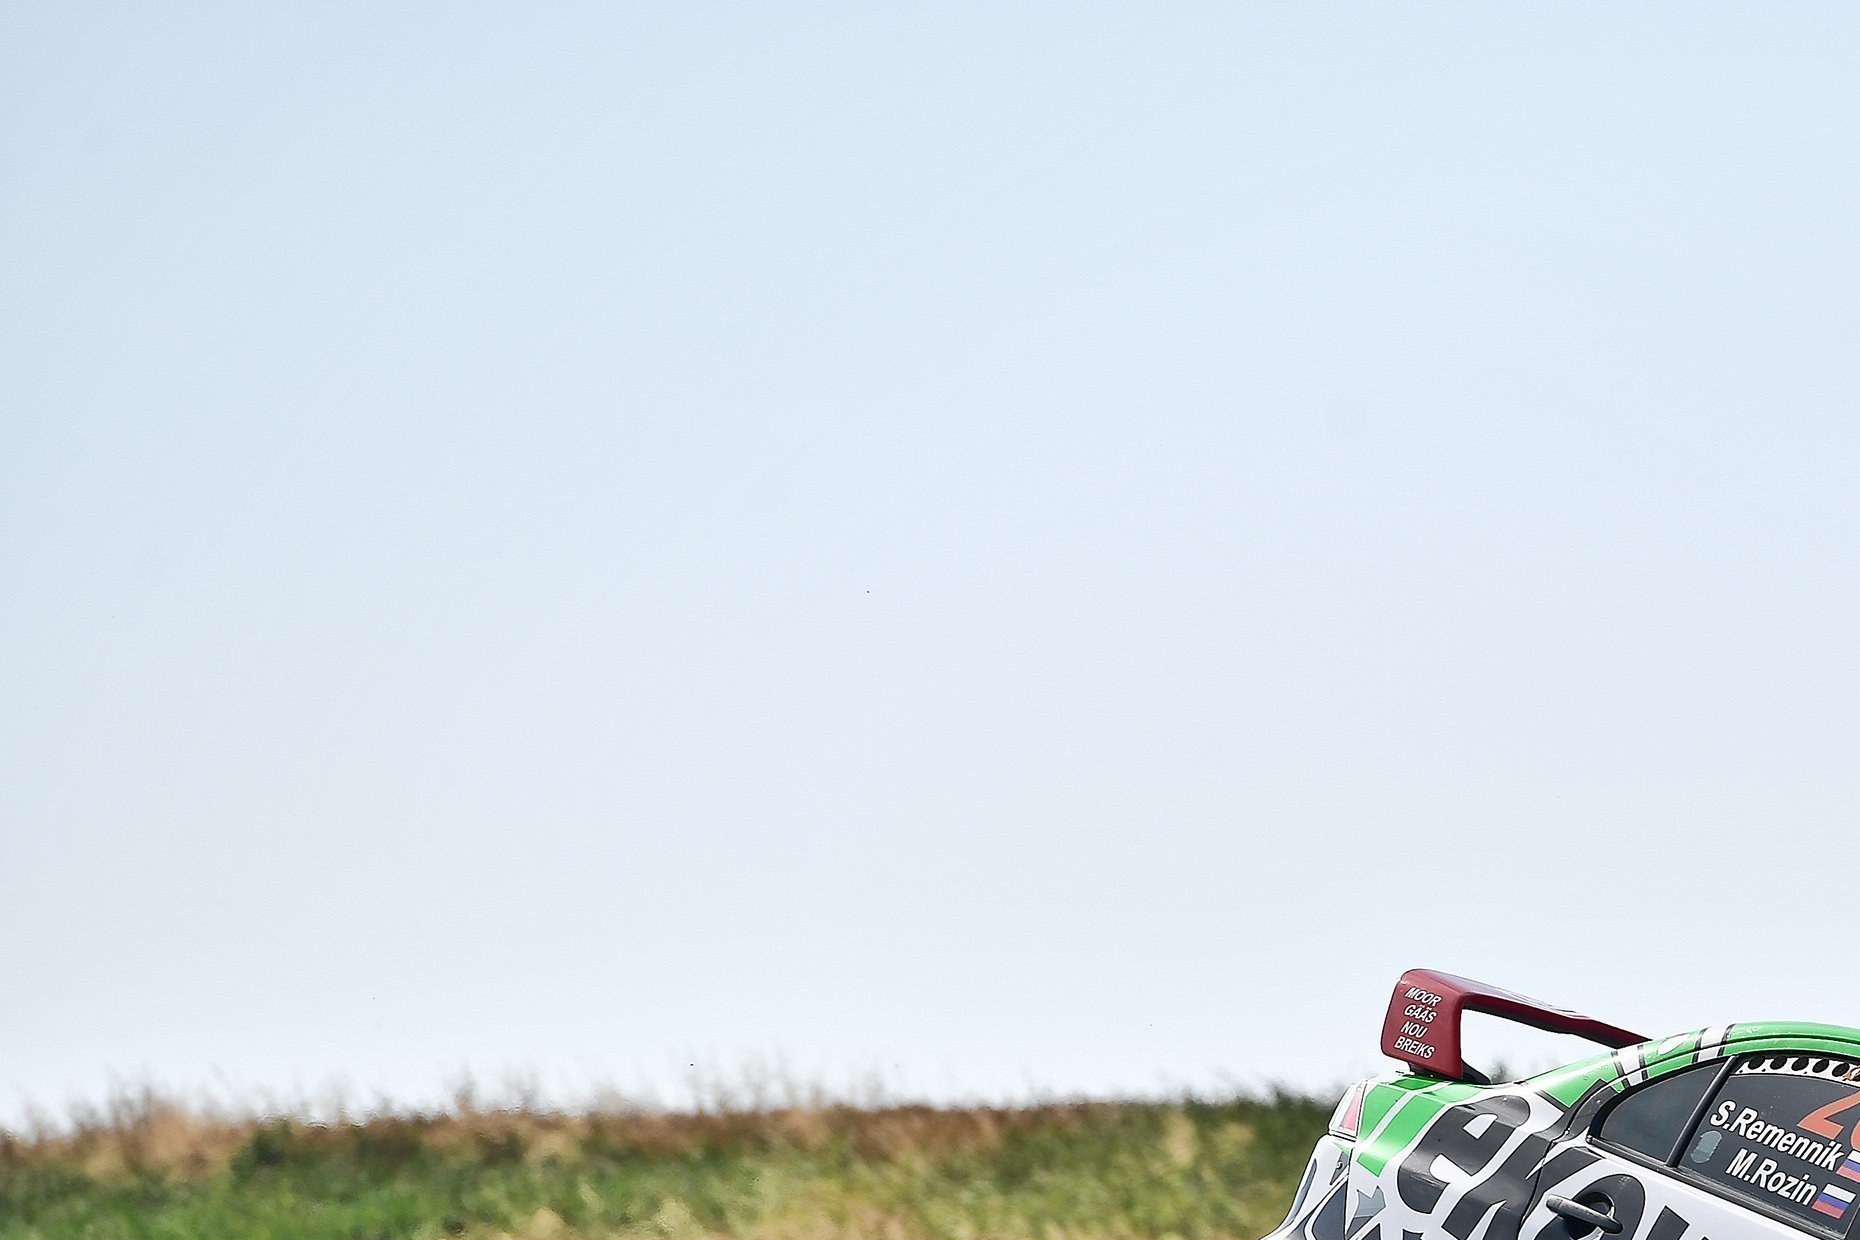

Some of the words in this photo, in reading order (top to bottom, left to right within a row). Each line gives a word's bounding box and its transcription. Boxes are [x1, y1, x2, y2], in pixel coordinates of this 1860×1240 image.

[1404, 986, 1442, 1007] MOOR
[1400, 1020, 1428, 1038] NOU
[1394, 1036, 1435, 1058] BREIKS
[1710, 1100, 1845, 1172] S.Remennik
[1725, 1148, 1818, 1206] M.Rozin
